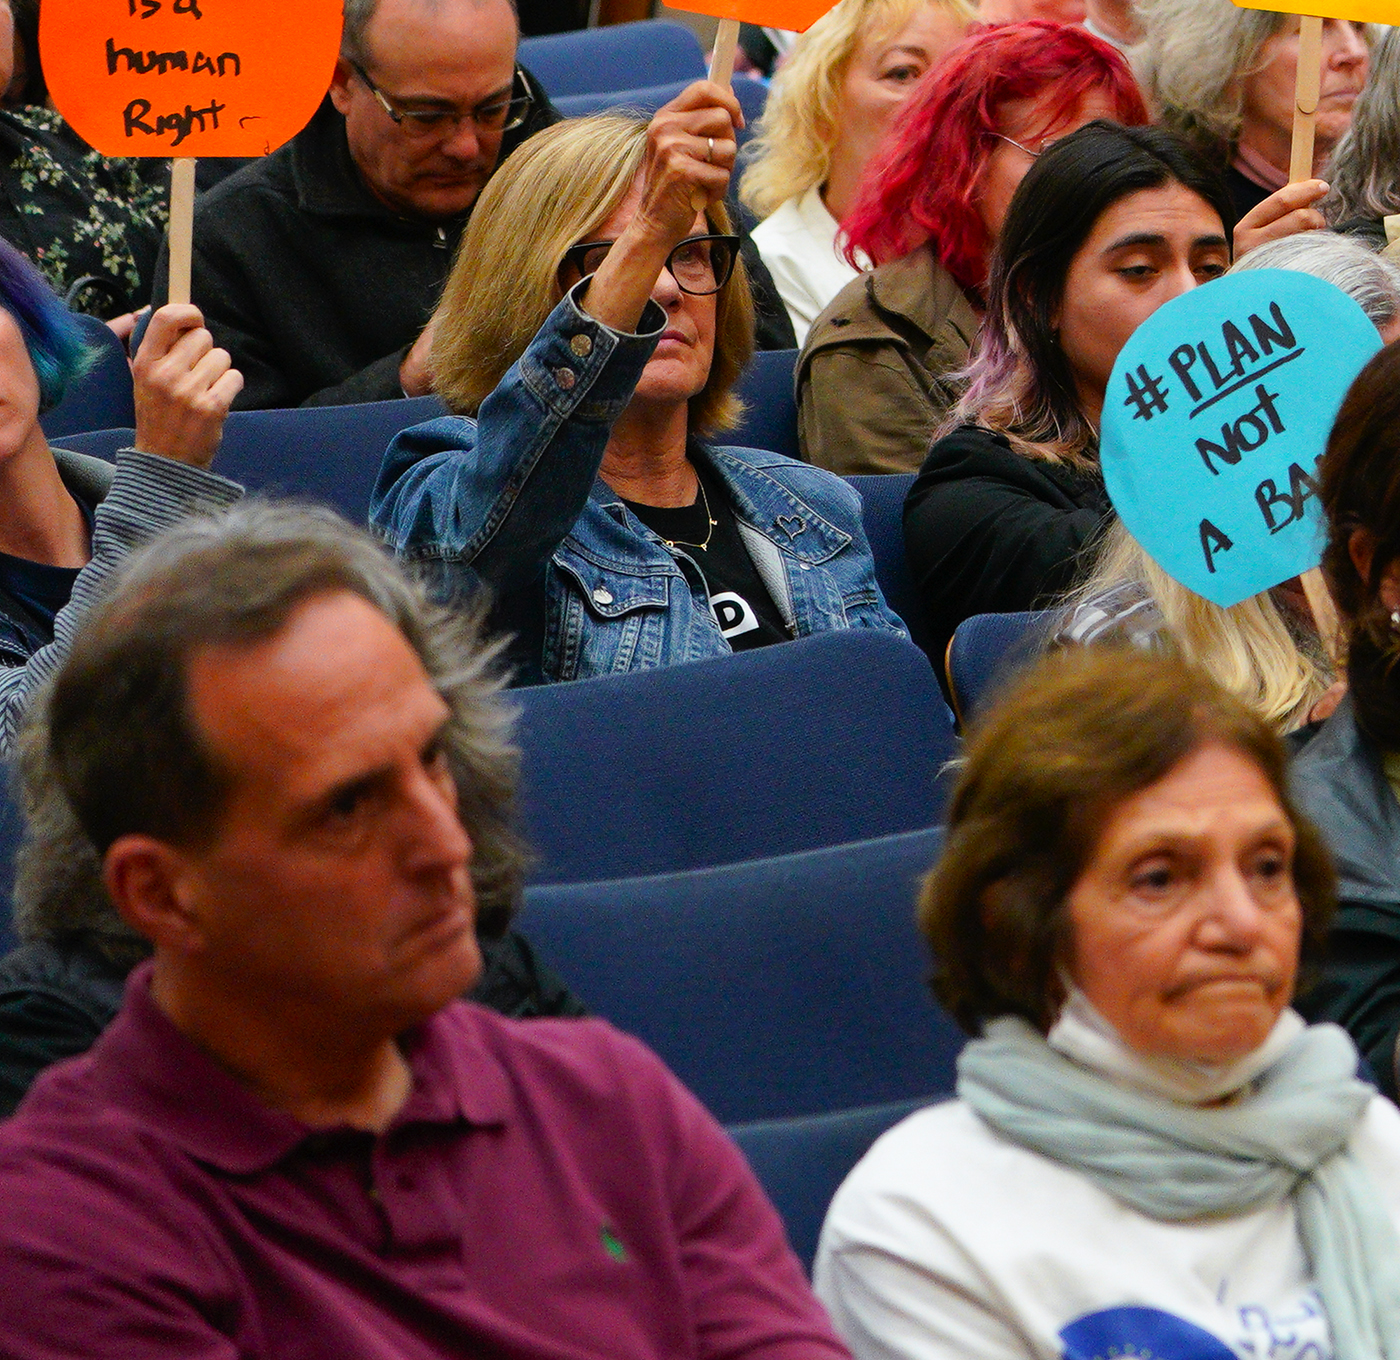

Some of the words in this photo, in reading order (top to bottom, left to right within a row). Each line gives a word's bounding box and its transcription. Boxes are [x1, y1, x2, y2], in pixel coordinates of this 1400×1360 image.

[105, 37, 240, 78] human
[122, 98, 226, 147] Right
[1124, 301, 1297, 421] #PLAN
[1199, 518, 1234, 574] A
[1254, 453, 1326, 536] BA
